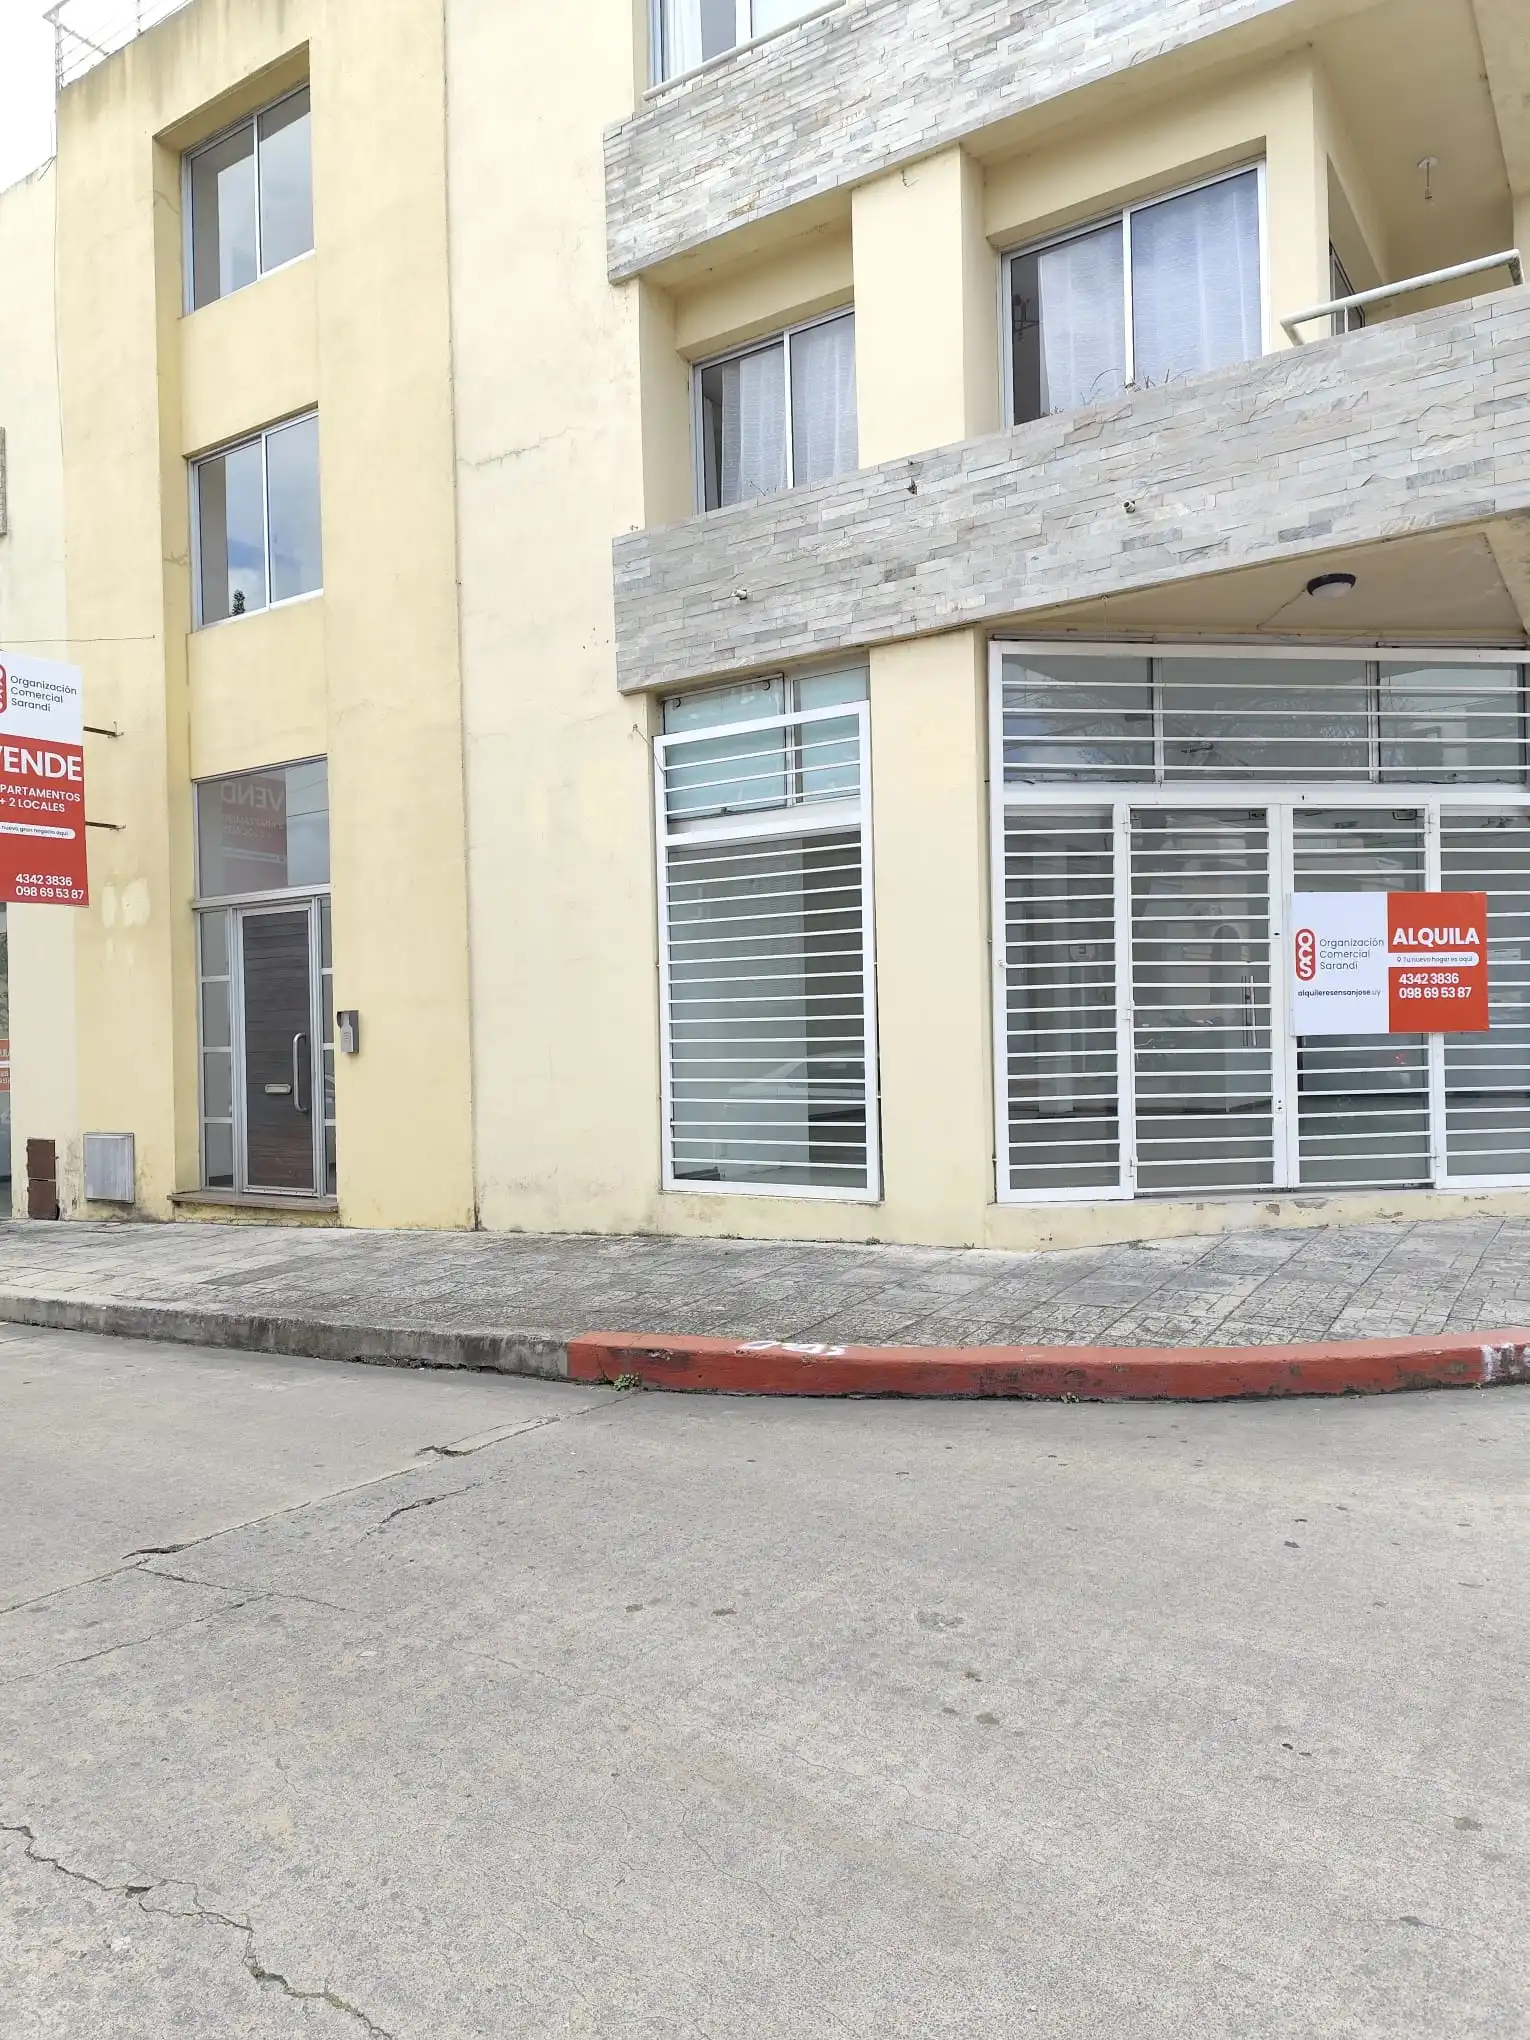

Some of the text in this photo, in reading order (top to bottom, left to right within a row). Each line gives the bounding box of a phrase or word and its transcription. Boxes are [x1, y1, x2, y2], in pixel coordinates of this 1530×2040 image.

[10, 675, 77, 695] Organización
[10, 686, 63, 703] Comercial
[0, 745, 83, 782] ENDE
[9, 797, 16, 807] 2
[18, 798, 66, 813] LOCALES
[16, 873, 73, 887] 4342 3836
[16, 885, 85, 900] 098 69 53 87
[1319, 937, 1385, 950] Organización
[1392, 927, 1480, 948] ALQUILA
[1319, 949, 1371, 959] Comercial
[1398, 972, 1460, 984] 4342 3836
[1297, 989, 1381, 998] alquileresensanjose.uy
[1399, 986, 1473, 998] 098 69 53 87
